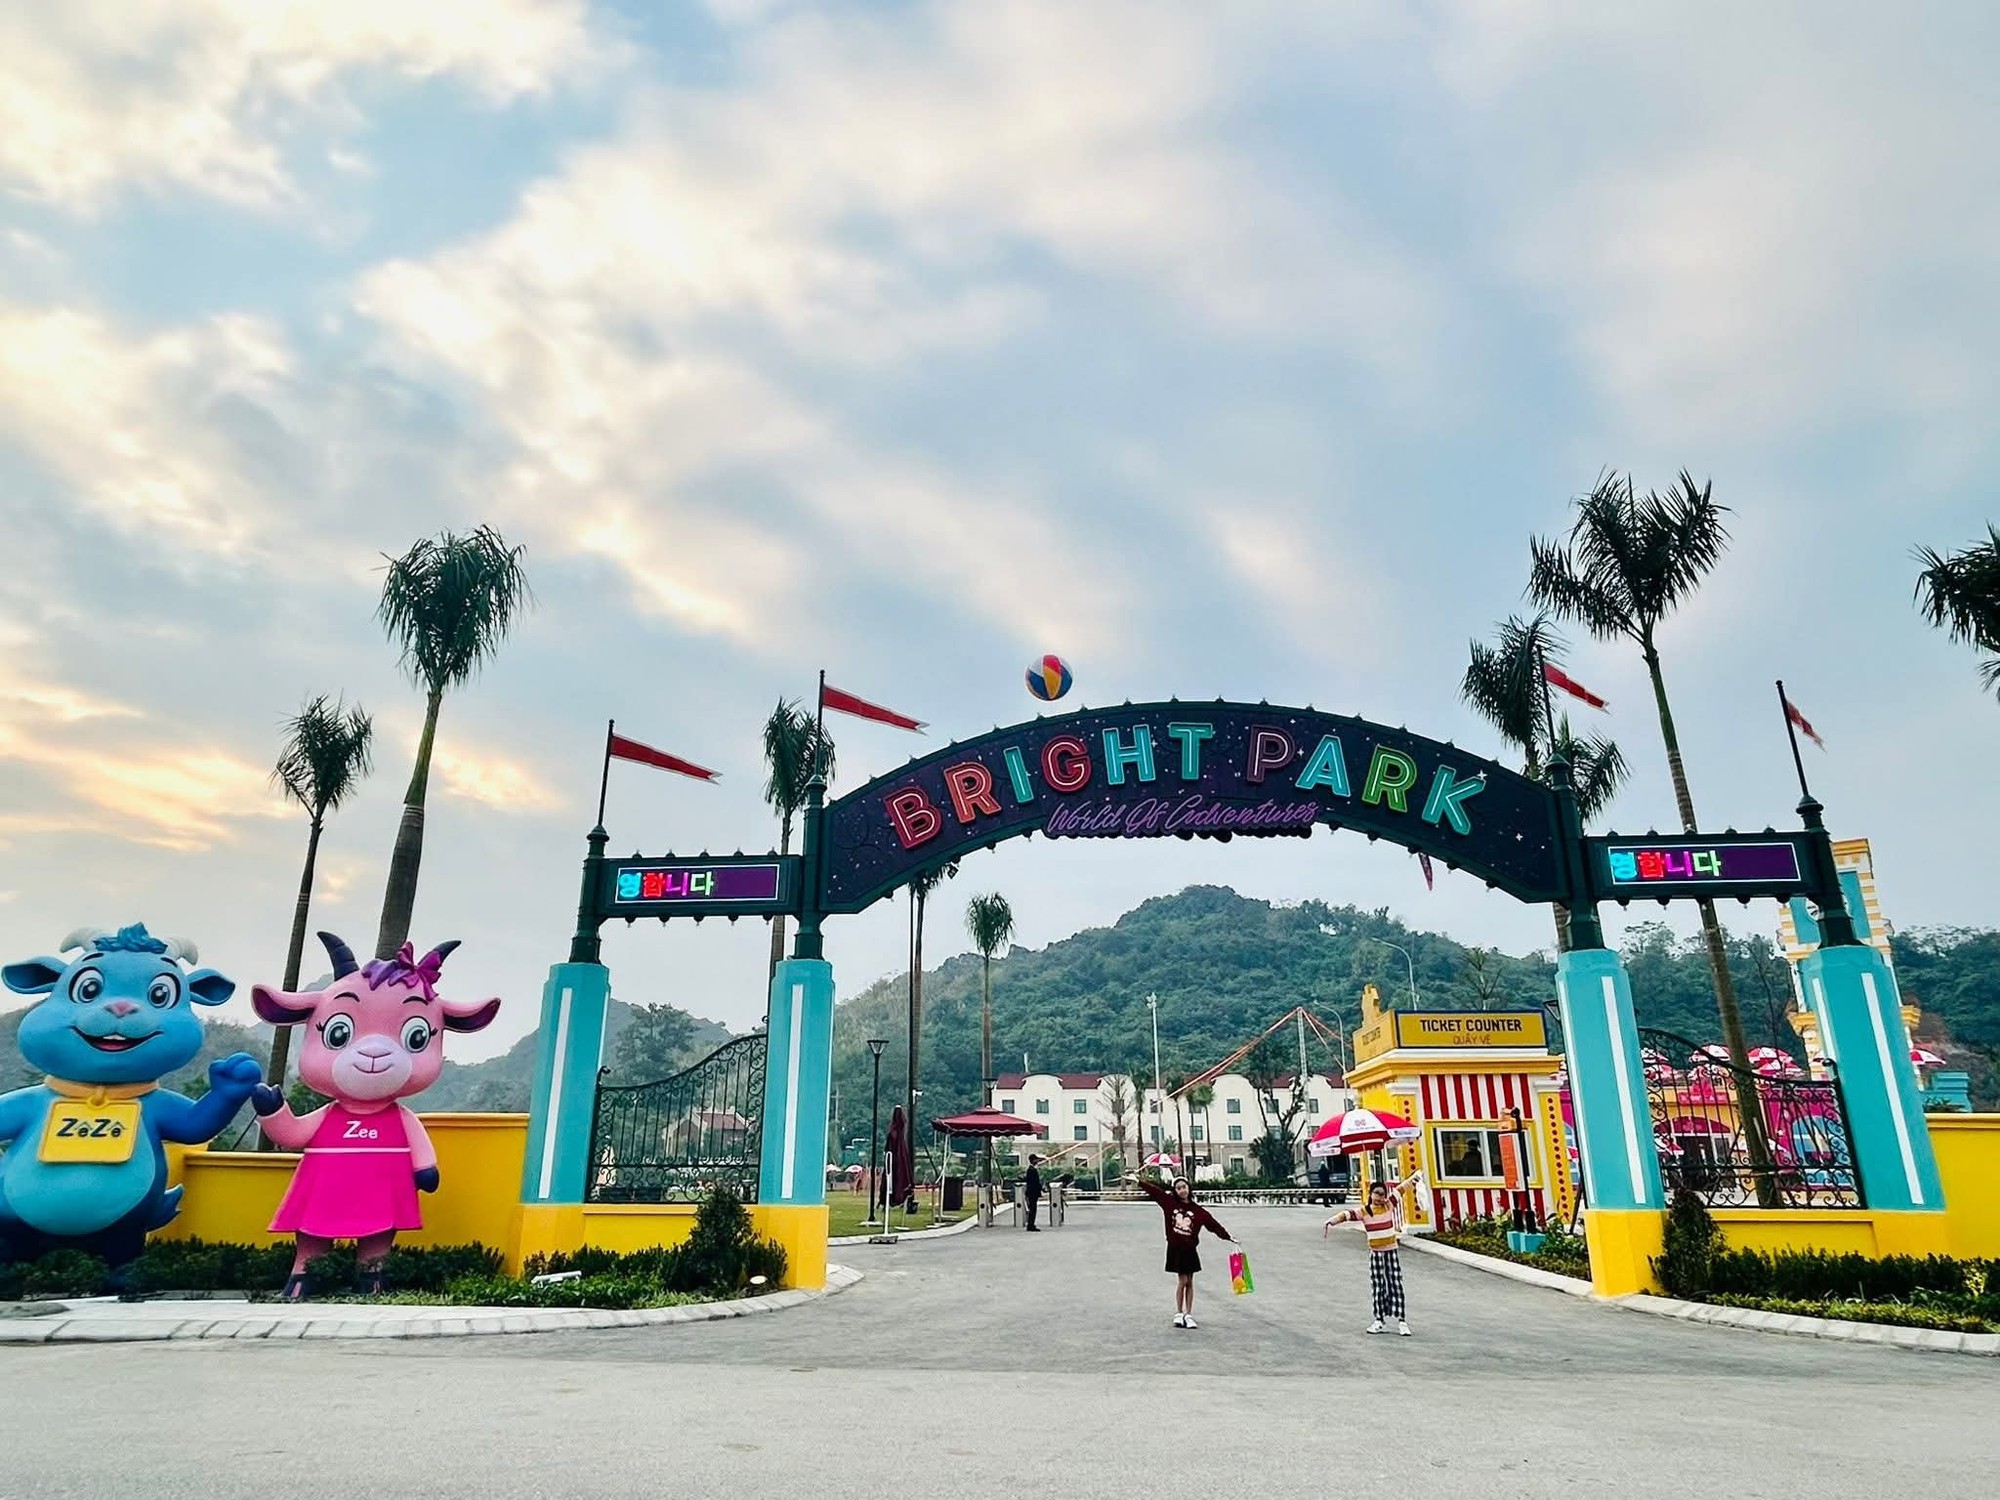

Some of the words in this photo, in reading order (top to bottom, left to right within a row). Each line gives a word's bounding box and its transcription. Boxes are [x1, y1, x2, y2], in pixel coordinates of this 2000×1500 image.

[885, 721, 1213, 849] BRIGHT
[1246, 725, 1486, 835] PARK
[1046, 799, 1122, 833] World
[1124, 797, 1170, 833] Of
[1164, 794, 1320, 830] Adventures
[1420, 1019, 1462, 1032] TICKET
[1465, 1018, 1522, 1032] COUNTER
[342, 1120, 378, 1139] Zee
